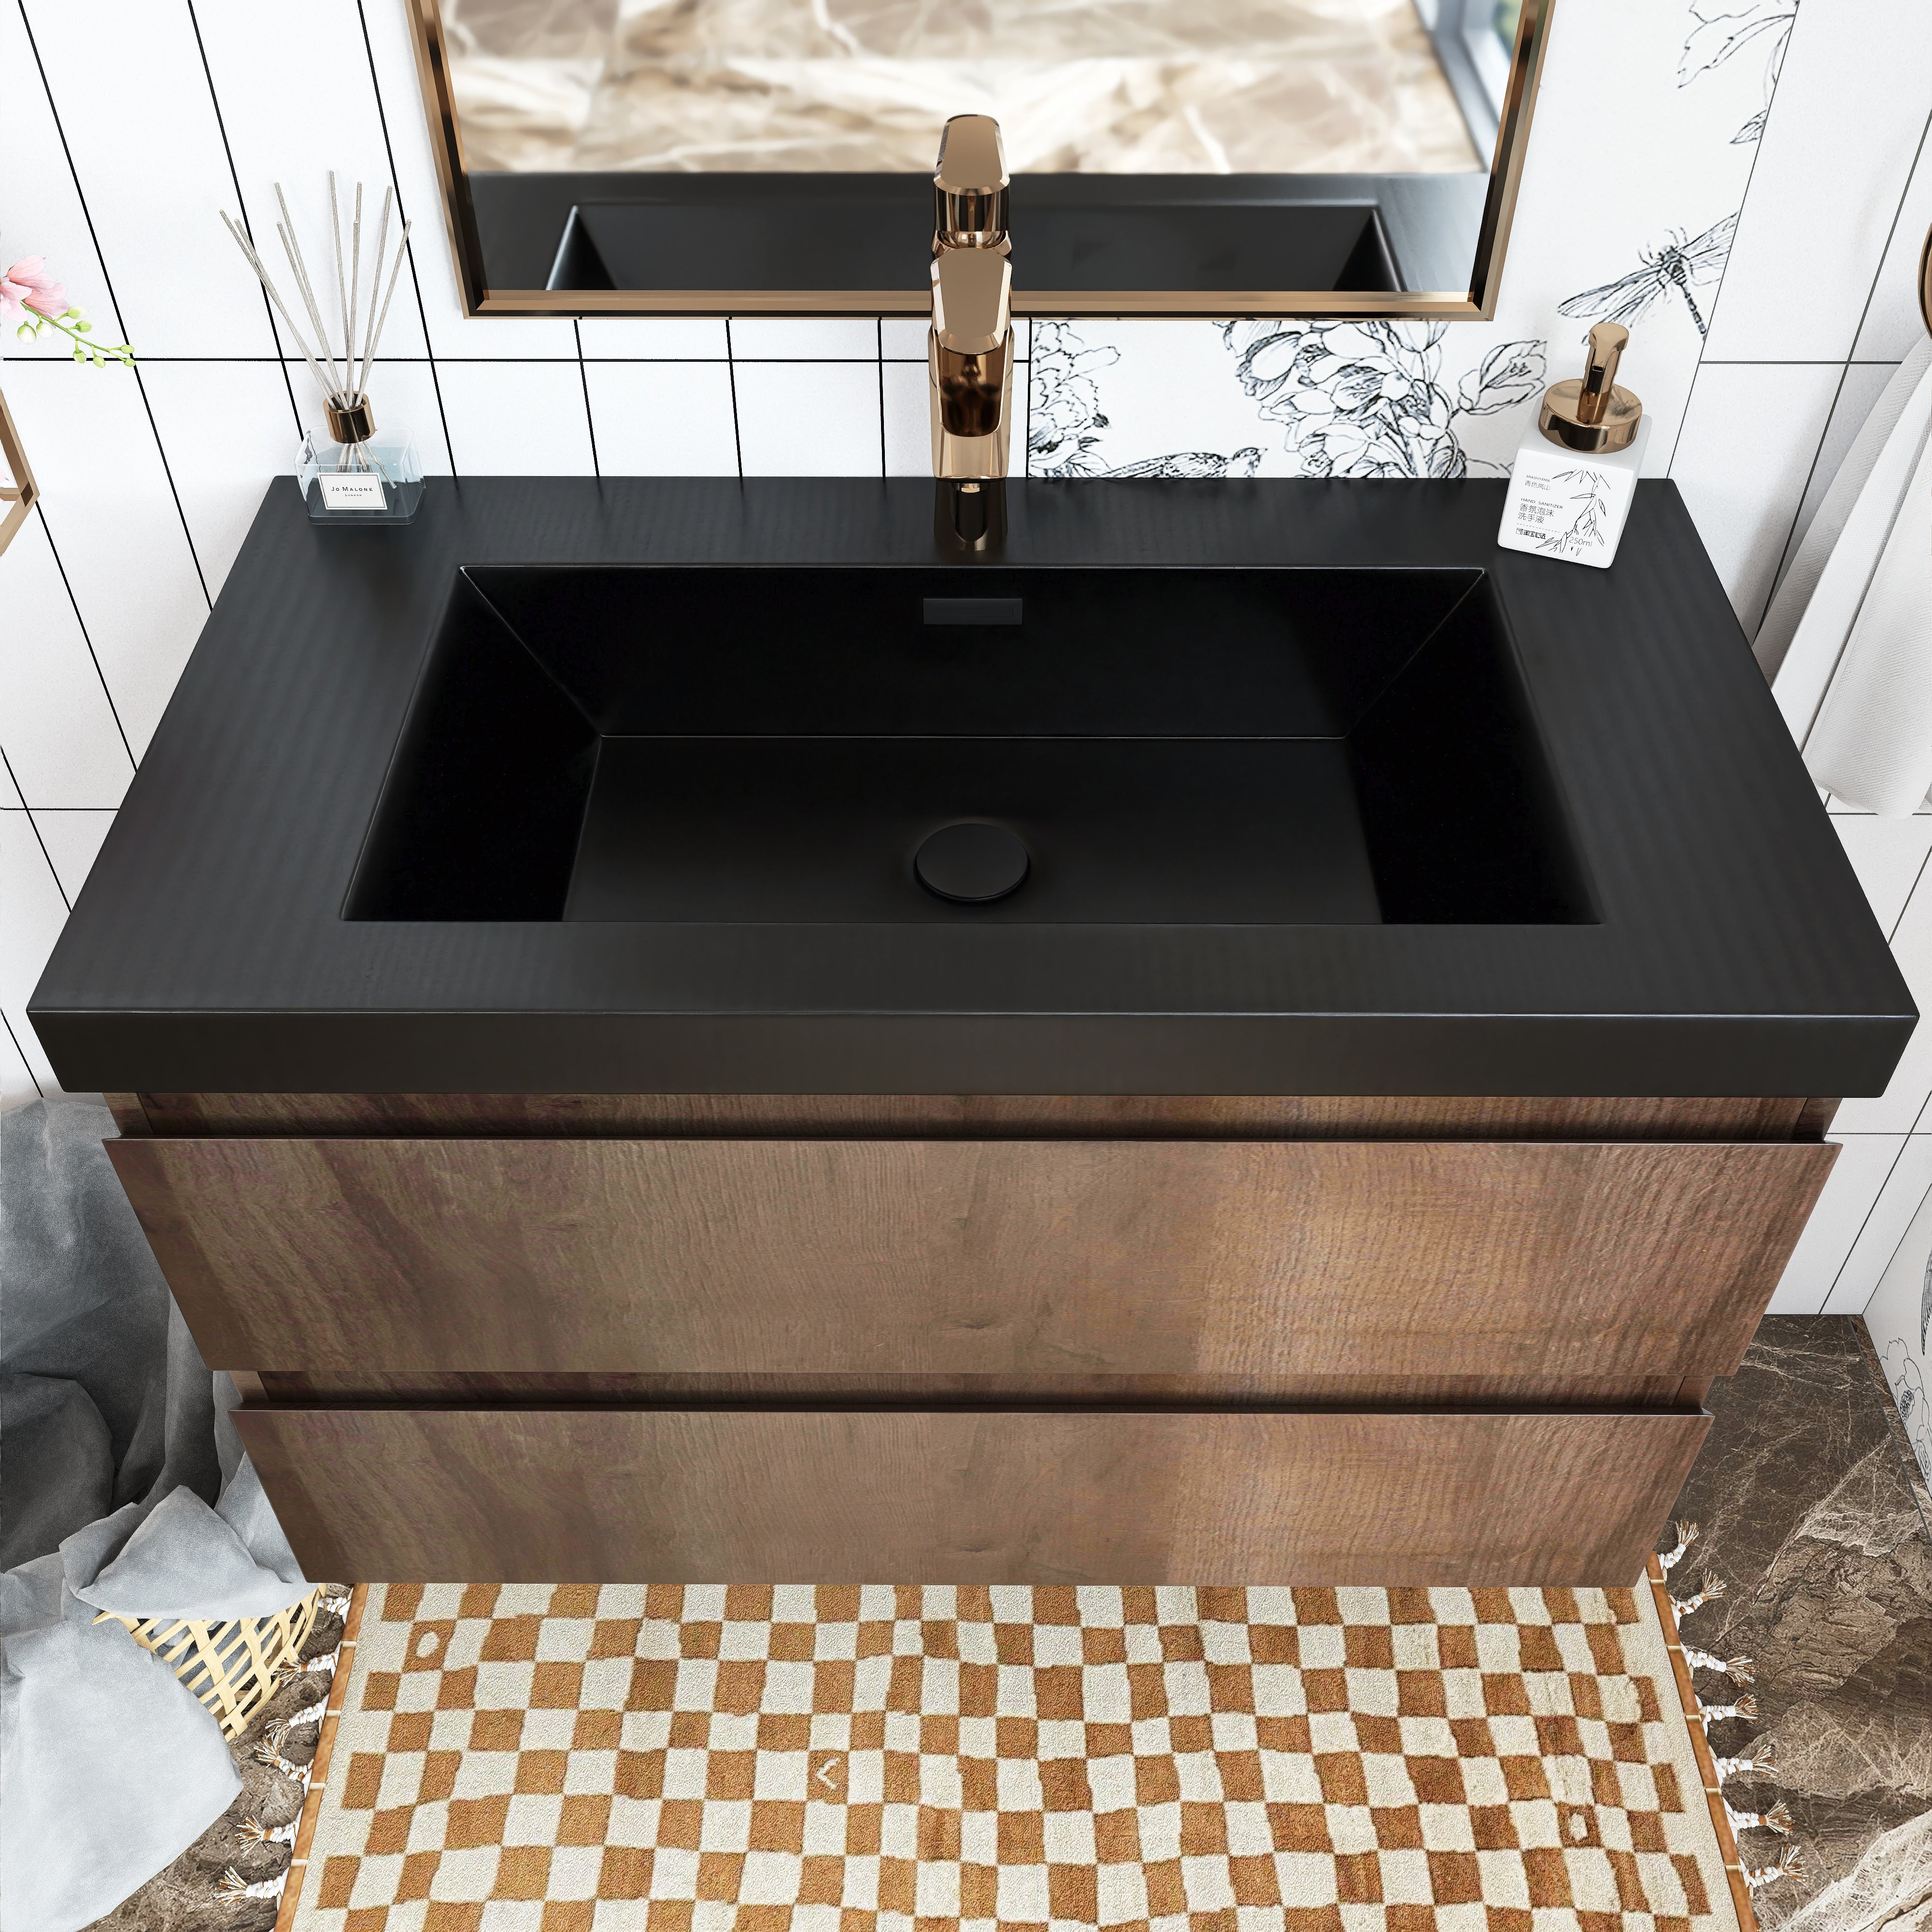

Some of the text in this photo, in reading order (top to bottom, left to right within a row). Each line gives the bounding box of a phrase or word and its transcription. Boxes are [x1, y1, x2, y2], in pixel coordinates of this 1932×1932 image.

[1520, 503, 1554, 517] 香氛泡沫
[1518, 512, 1545, 524] 洗手液
[1569, 537, 1592, 547] 250ml
